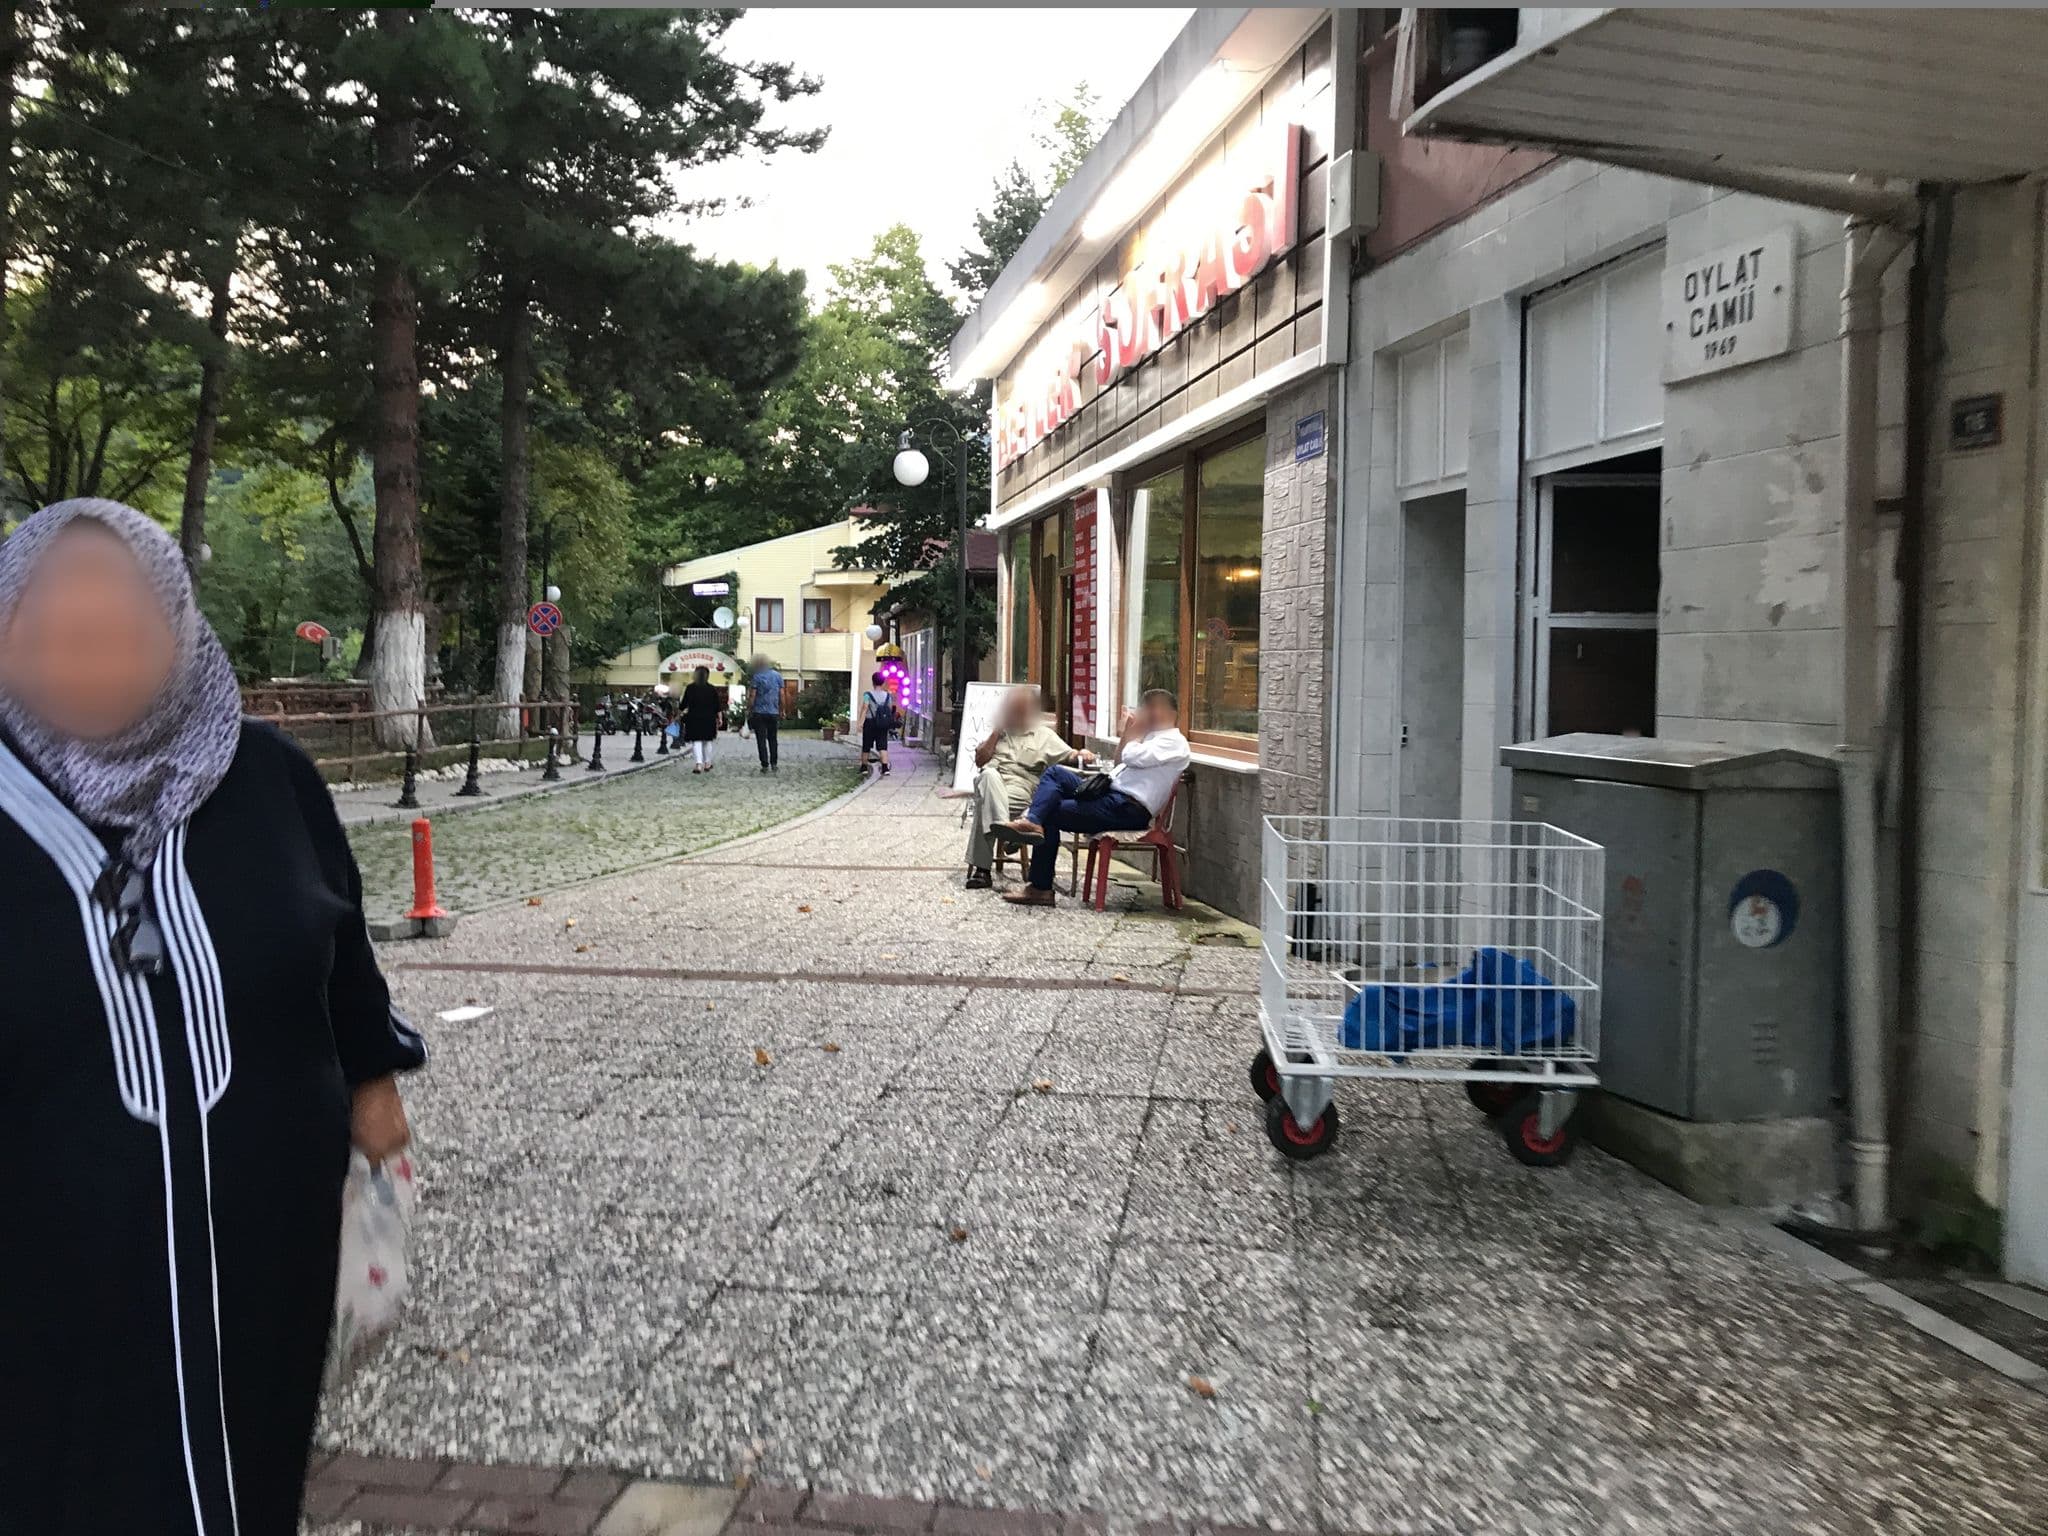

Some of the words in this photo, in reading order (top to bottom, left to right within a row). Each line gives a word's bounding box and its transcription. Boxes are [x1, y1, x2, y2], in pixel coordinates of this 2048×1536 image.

[1684, 246, 1765, 302] OYLAT
[1689, 283, 1755, 339] CAMİİ
[1703, 334, 1738, 361] 1969
